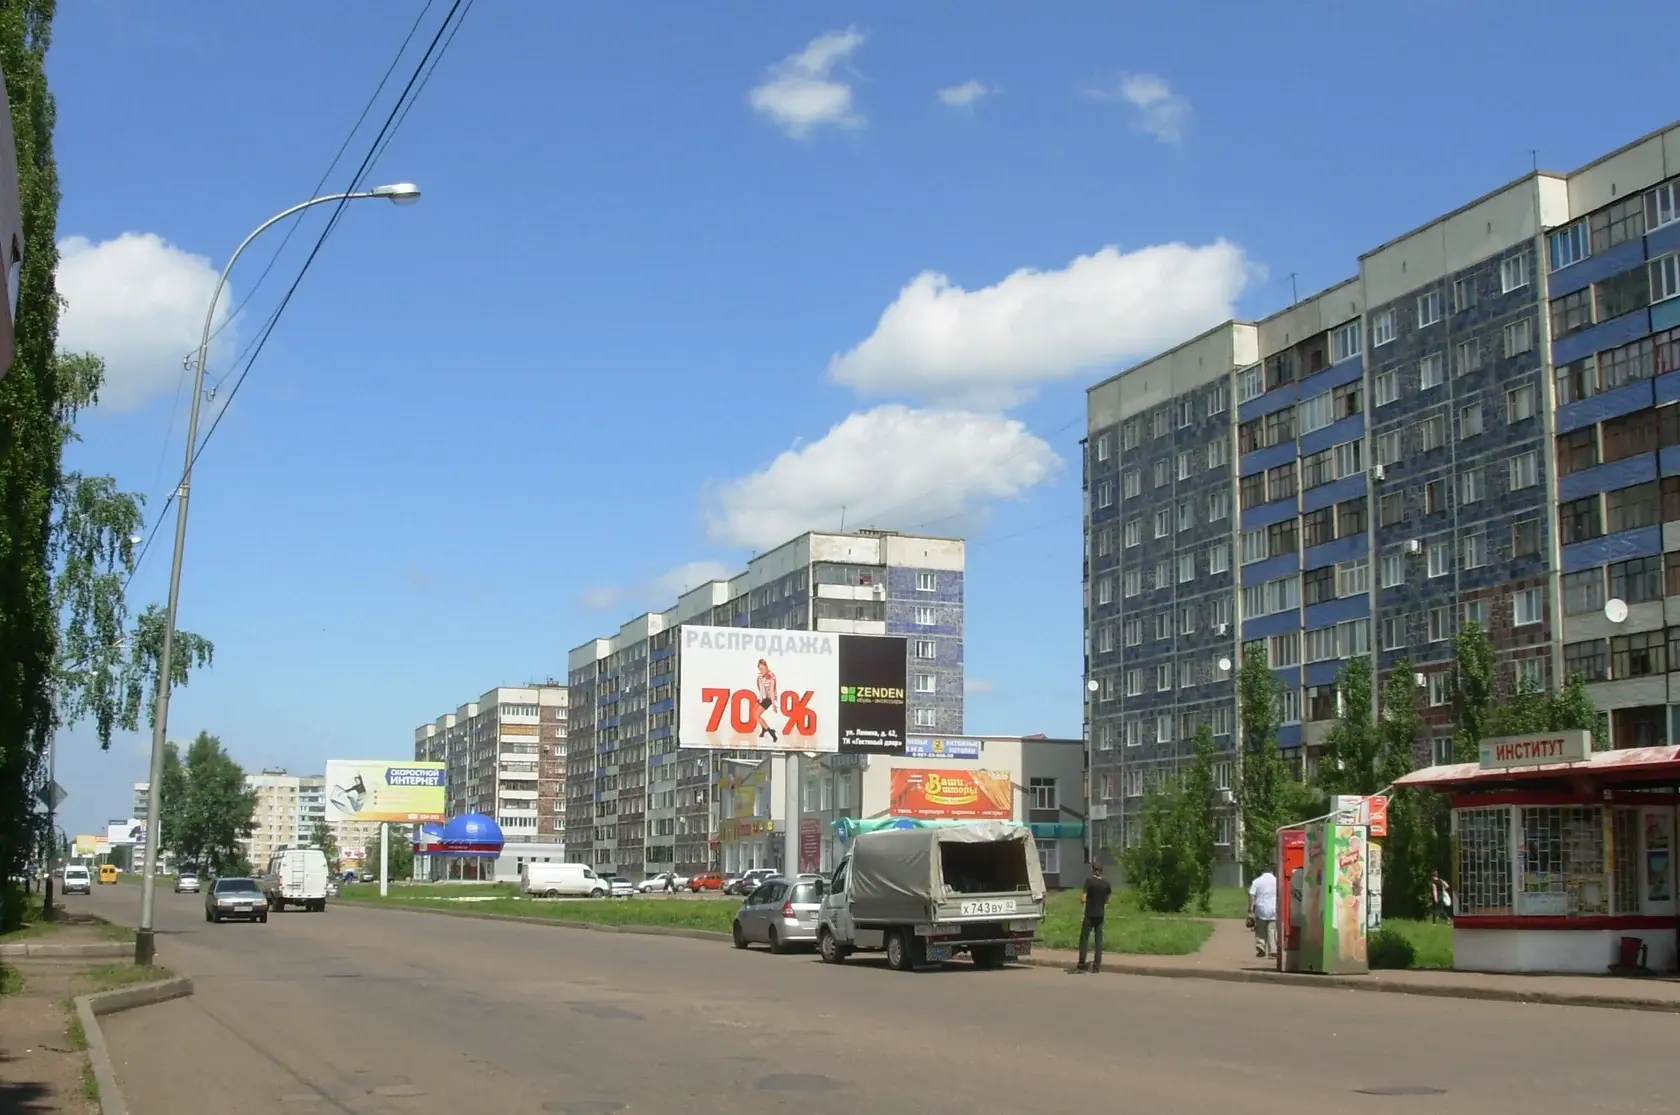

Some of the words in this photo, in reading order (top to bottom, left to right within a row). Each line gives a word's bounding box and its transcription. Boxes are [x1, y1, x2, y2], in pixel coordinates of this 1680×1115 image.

[686, 630, 833, 656] РАСПРОДАЖА
[857, 686, 904, 699] ZENDEN
[1496, 739, 1565, 761] ИНСТИТУТ
[390, 769, 439, 777] СКОРОСТНОЙ
[390, 776, 439, 786] ИНТЕРНЕТ
[925, 773, 964, 794] Ваши
